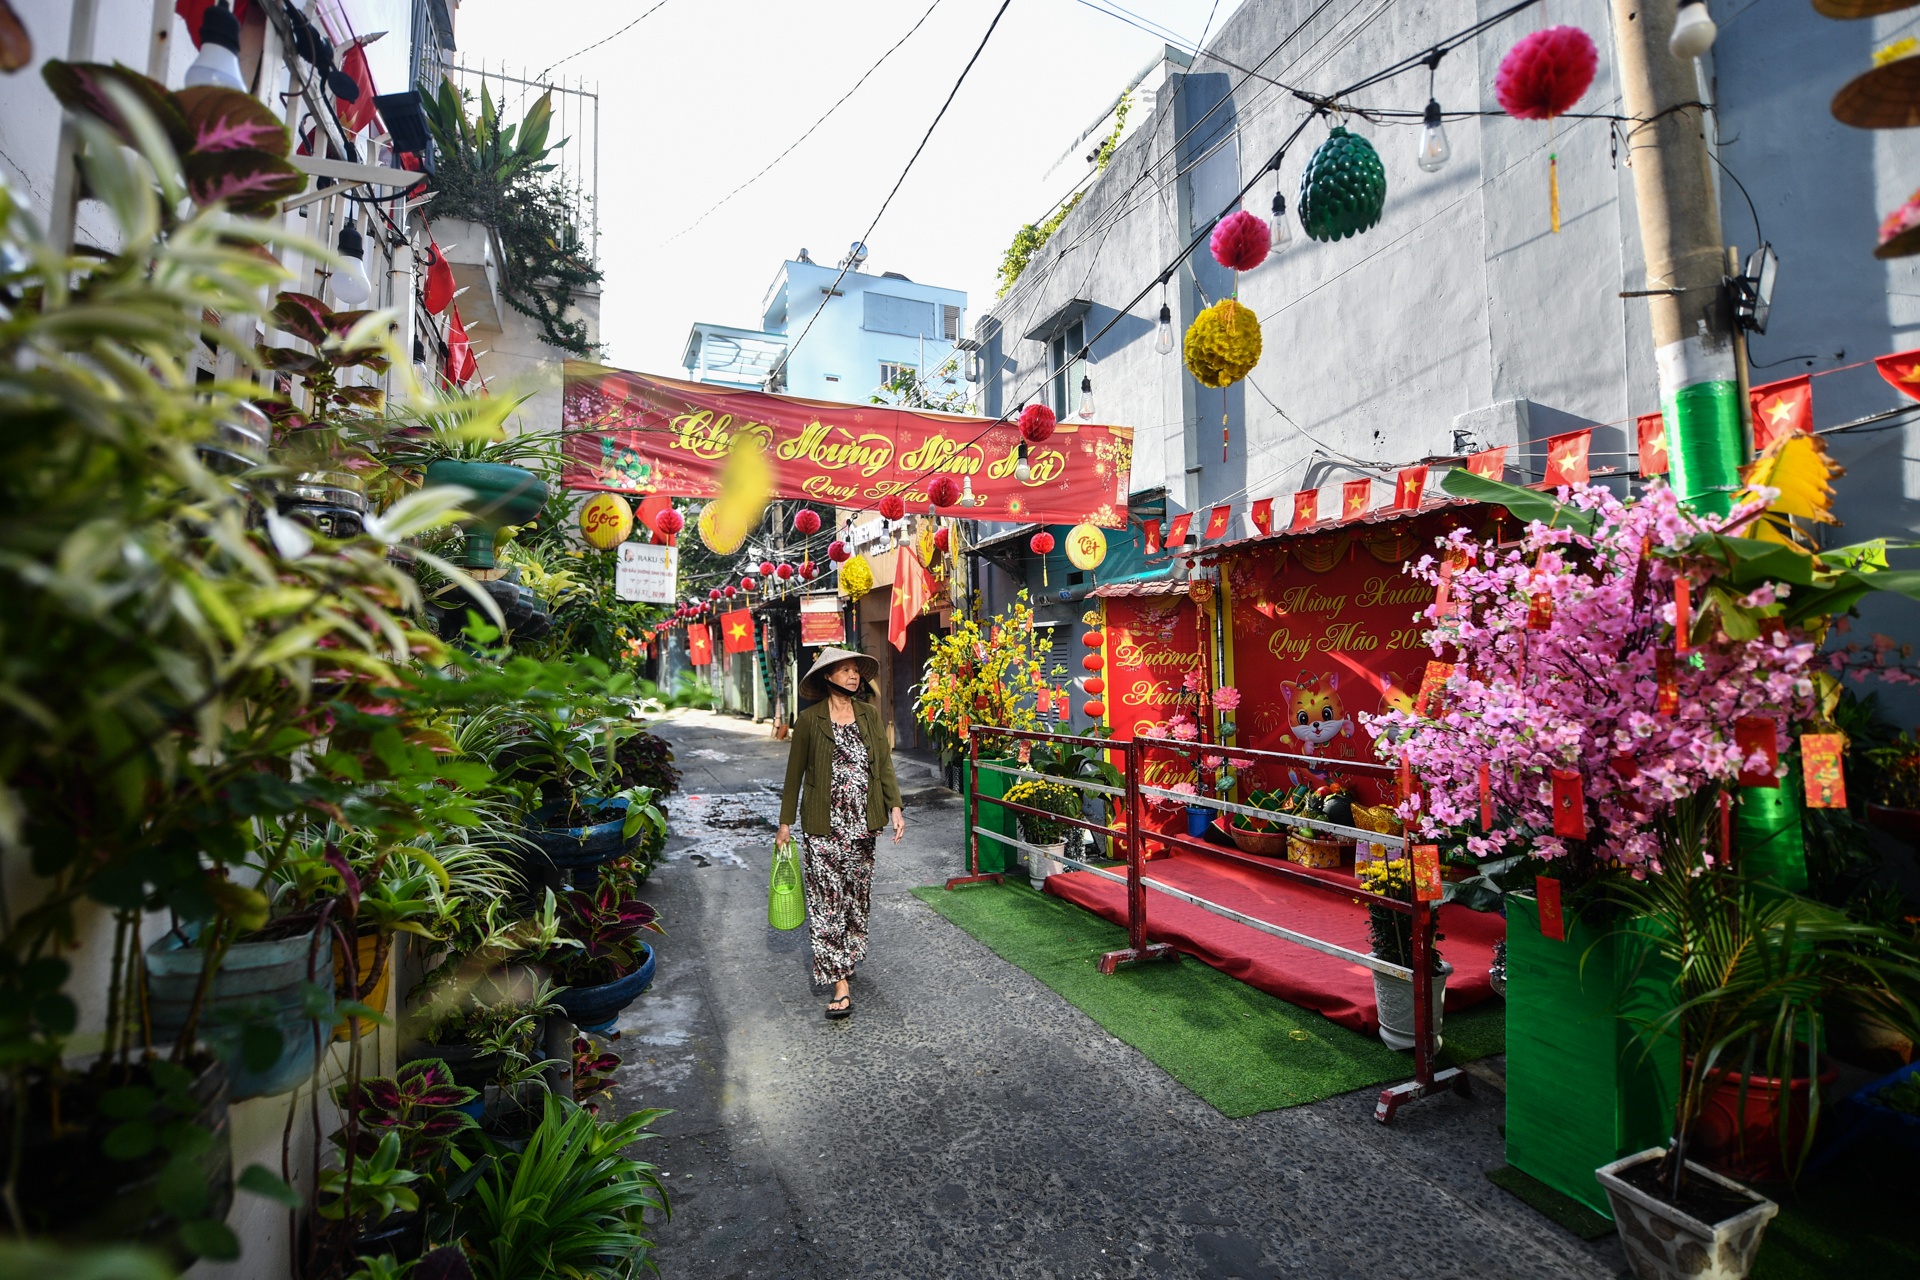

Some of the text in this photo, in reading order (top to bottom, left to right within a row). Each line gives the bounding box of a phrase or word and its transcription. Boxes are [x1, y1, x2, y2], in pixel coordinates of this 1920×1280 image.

[776, 421, 895, 478] Mừng
[899, 434, 985, 475] Năm
[801, 475, 859, 502] Quý
[586, 505, 619, 533] Góc
[637, 555, 673, 565] RAKU SA
[1078, 536, 1100, 560] Tết
[1275, 574, 1433, 620] Mừng Xuân
[1268, 621, 1430, 662] Quý Mão 202
[1115, 641, 1199, 673] Đường
